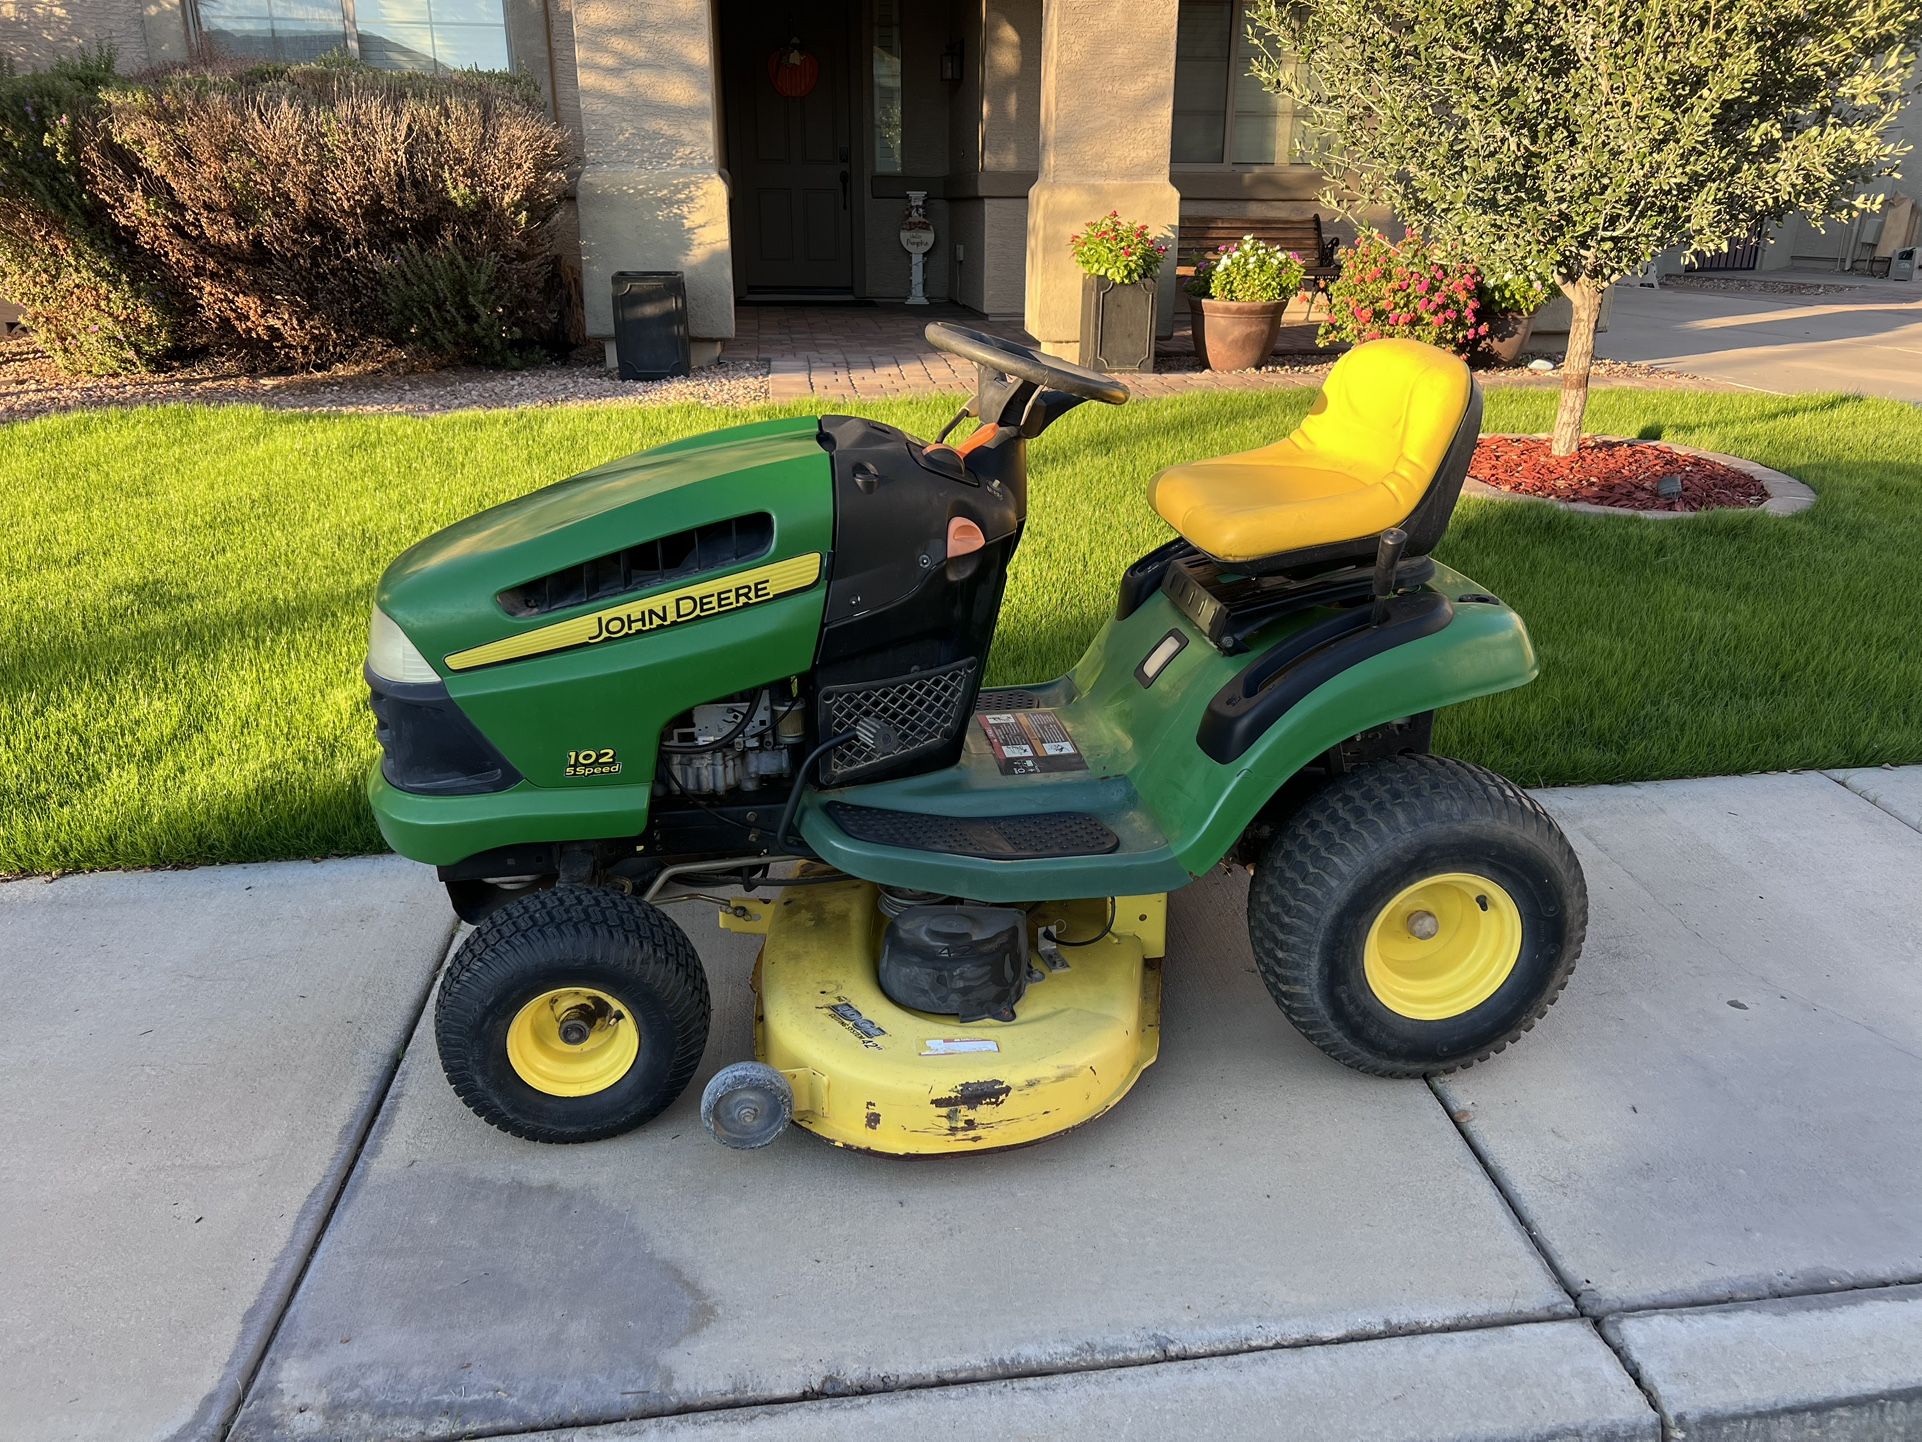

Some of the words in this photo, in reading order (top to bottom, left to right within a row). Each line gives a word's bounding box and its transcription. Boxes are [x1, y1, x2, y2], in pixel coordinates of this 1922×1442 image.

[588, 604, 668, 641] JOHN
[675, 579, 771, 619] DEERE
[568, 748, 615, 765] 102
